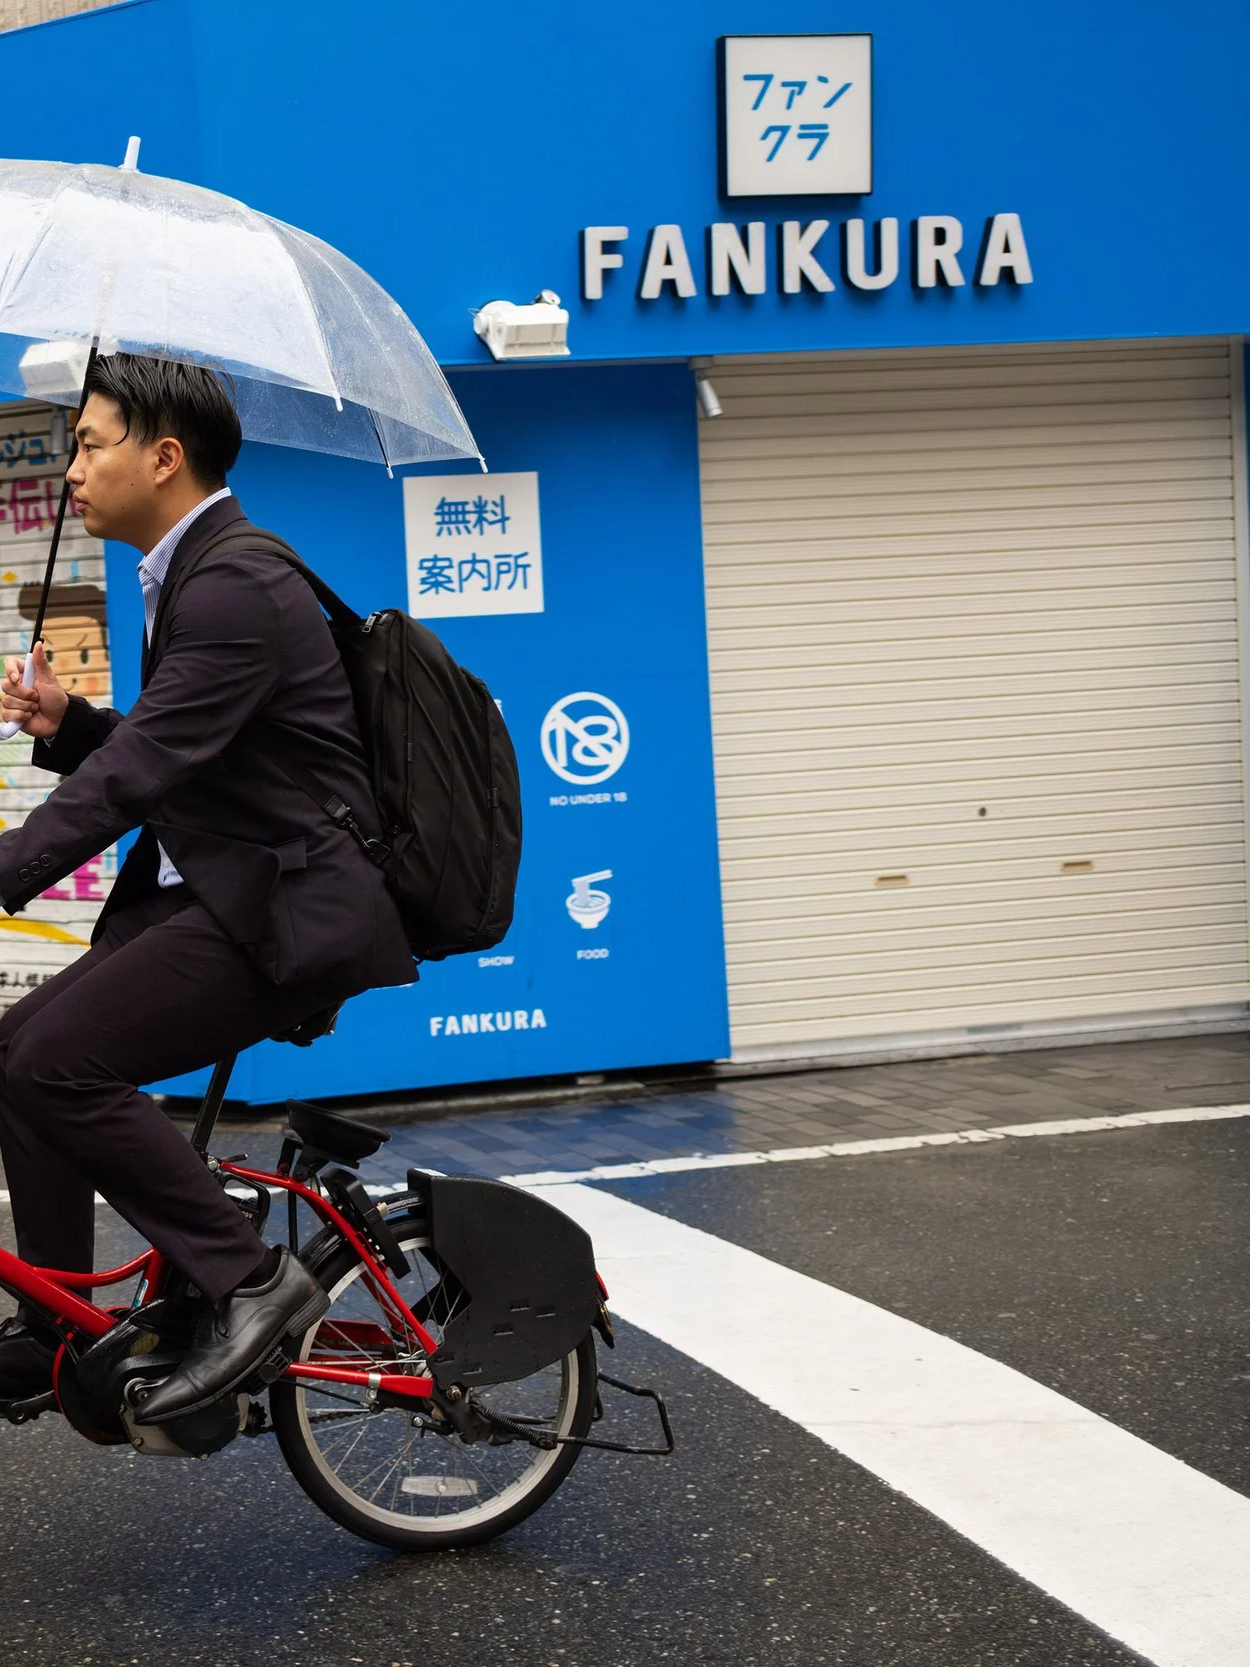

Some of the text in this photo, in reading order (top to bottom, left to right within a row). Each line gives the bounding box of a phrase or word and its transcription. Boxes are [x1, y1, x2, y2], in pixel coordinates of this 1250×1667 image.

[743, 74, 853, 111] ファン
[760, 123, 830, 162] クラ
[584, 213, 1034, 300] FANKURA
[434, 494, 511, 537] 無料
[418, 551, 532, 596] 案内所
[550, 792, 627, 806] NO UNDER 18
[478, 955, 515, 968] SHOW
[577, 949, 609, 960] FOOD
[430, 1009, 547, 1037] FANKURA
